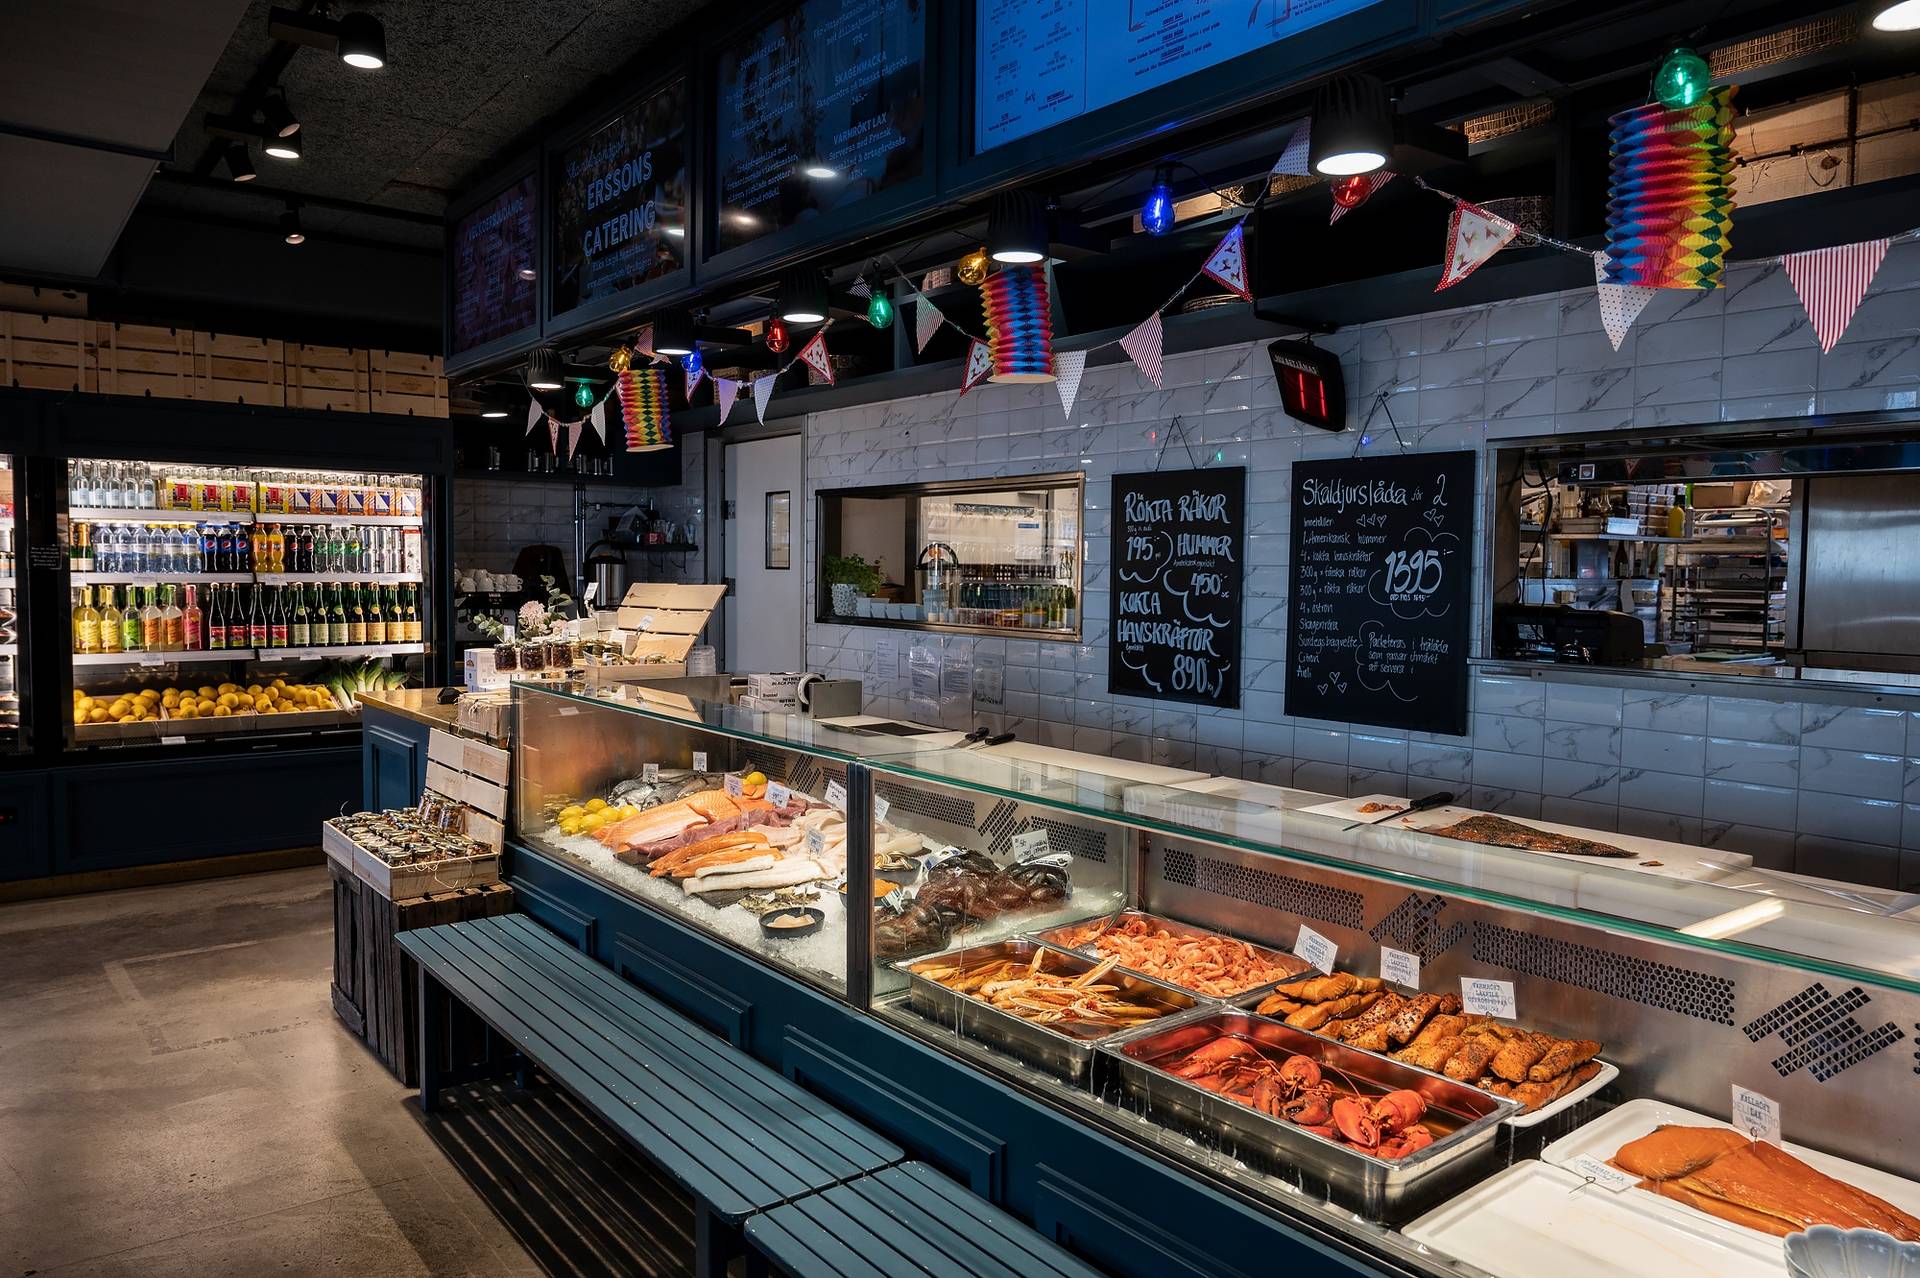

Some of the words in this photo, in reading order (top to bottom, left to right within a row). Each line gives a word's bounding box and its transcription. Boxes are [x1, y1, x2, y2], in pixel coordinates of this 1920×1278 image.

[834, 50, 888, 87] SKAGENMACKA
[833, 118, 873, 146] VARMRÖKT
[873, 112, 888, 128] LAX
[586, 151, 654, 211] ERSSONS
[583, 200, 656, 257] CATERING
[1299, 371, 1327, 417] 11
[1124, 491, 1174, 523] RÖKTA
[1178, 490, 1231, 524] RÄKOR
[1302, 478, 1409, 514] Skaldjurslåda
[1433, 473, 1448, 507] 2
[1178, 533, 1236, 563] HUMMER
[1357, 531, 1388, 545] hummer
[1120, 591, 1162, 615] KOKTA
[1118, 619, 1221, 657] HAVSKRÄFTOR
